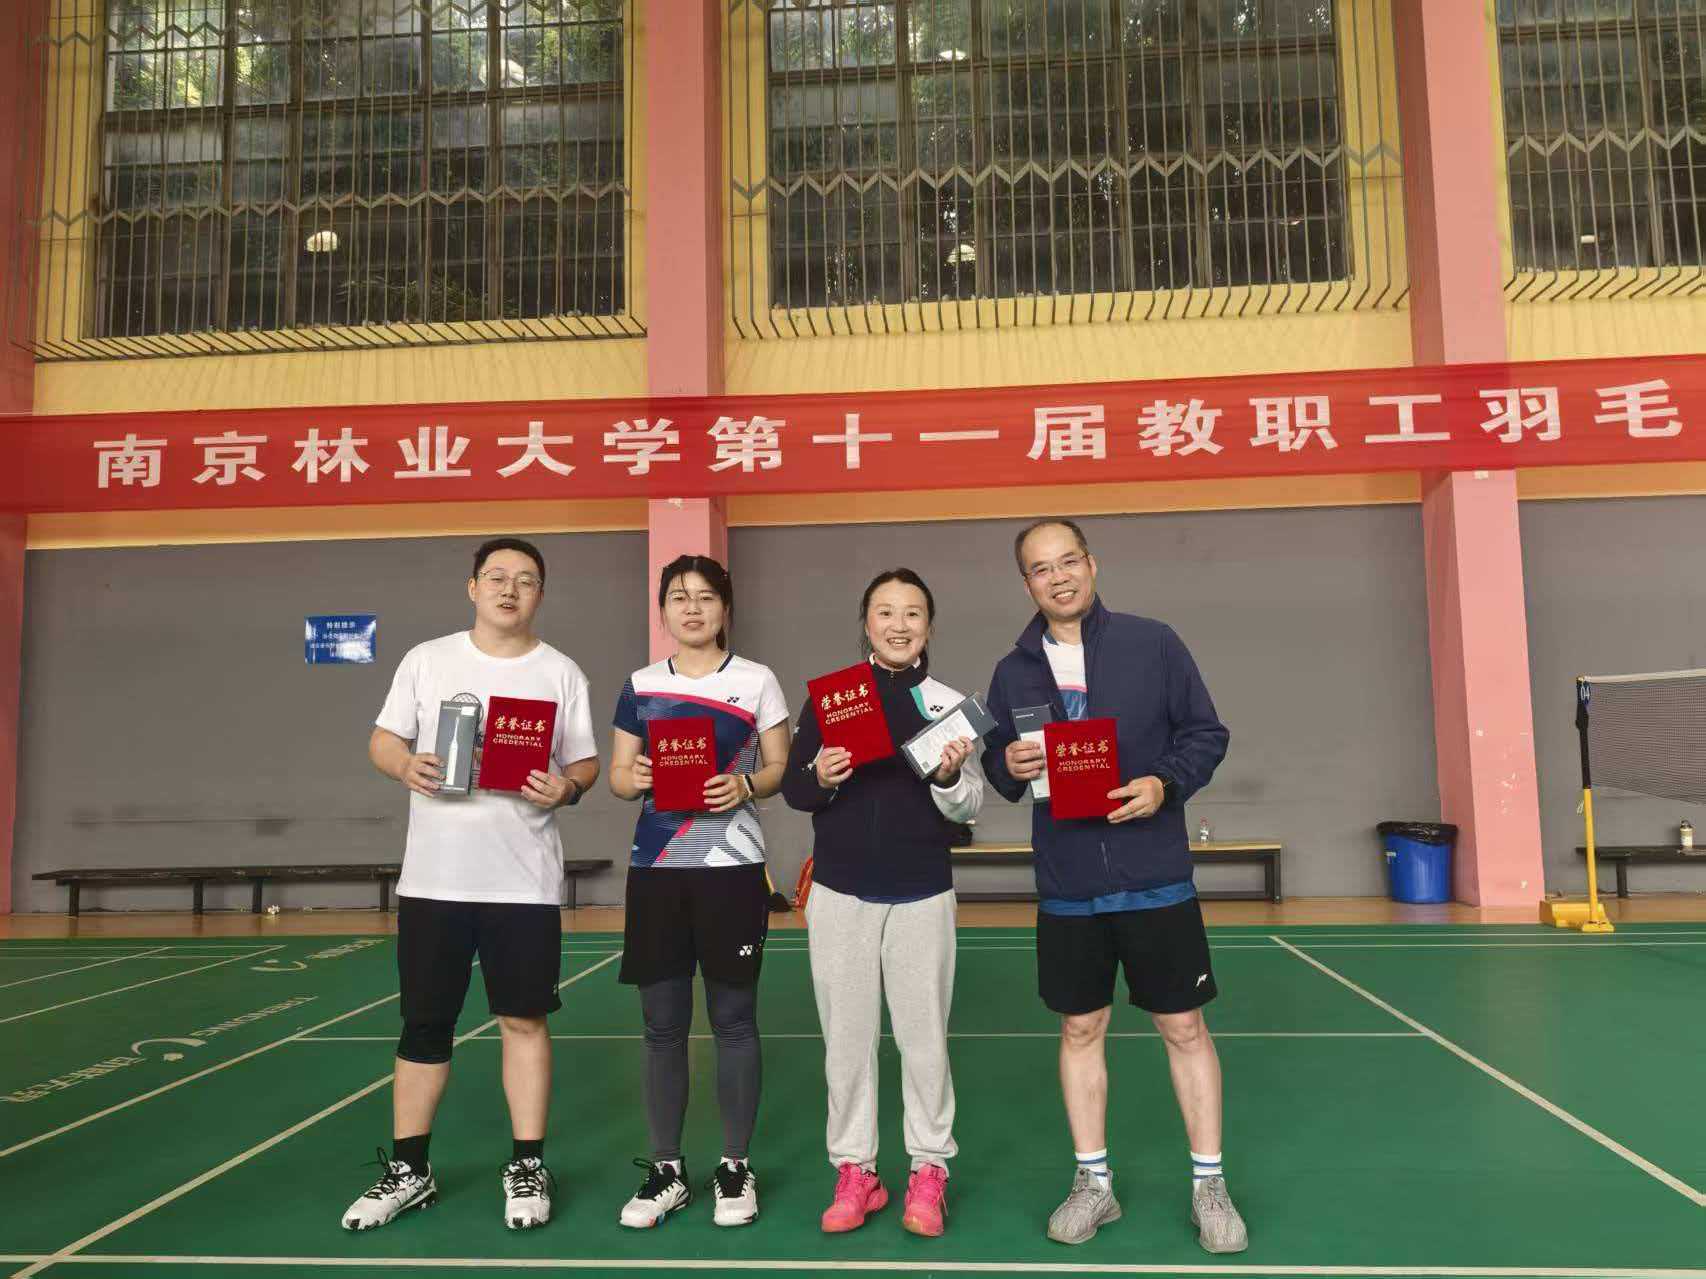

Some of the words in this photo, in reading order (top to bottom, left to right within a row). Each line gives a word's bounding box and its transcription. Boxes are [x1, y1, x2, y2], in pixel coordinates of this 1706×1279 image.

[92, 378, 1685, 489] 南京林业大学第十一届教职工羽毛
[821, 683, 868, 710] 荣誉证书
[825, 706, 874, 725] CREDENTIAL
[826, 702, 869, 718] HONORARY
[494, 715, 546, 733] 荣誉证书
[492, 738, 544, 748] CREDENTIAL
[496, 733, 541, 741] HONORARY
[657, 736, 707, 752] 荣誉证书
[1055, 739, 1109, 757] 荣誉证书
[658, 759, 708, 767] CREDENTIAL
[661, 753, 705, 761] HONORARY
[1058, 757, 1107, 766] HONORARY
[1056, 763, 1110, 773] CREDENTIAL
